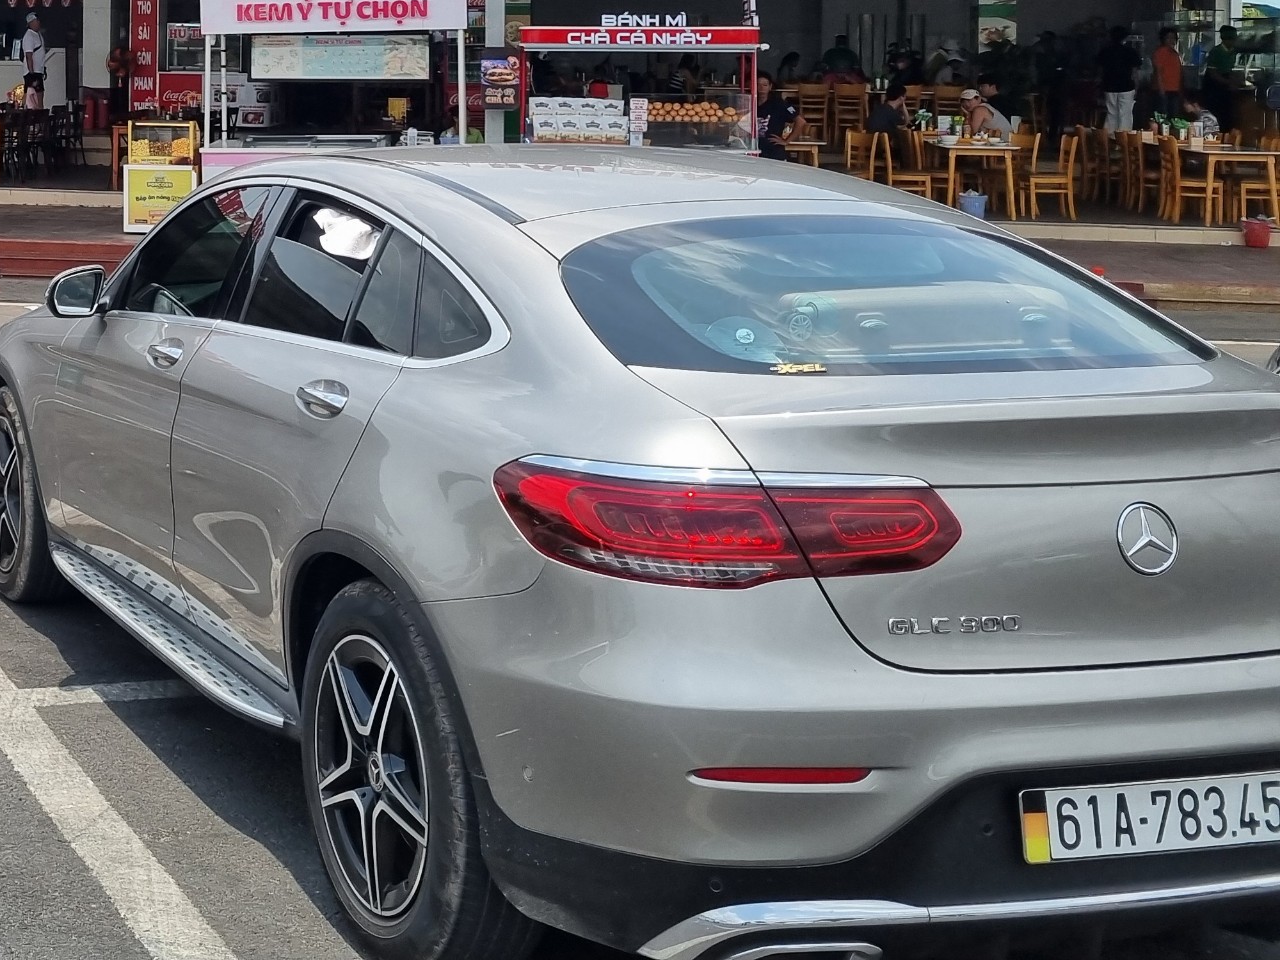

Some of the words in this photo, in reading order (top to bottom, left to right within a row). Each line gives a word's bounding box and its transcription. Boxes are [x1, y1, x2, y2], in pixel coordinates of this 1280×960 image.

[136, 0, 153, 15] THO
[236, 1, 294, 23] KEM
[601, 12, 658, 26] BÁNH
[666, 11, 687, 26] MÌ
[137, 22, 151, 41] SÀI
[136, 48, 152, 66] GÒN
[133, 76, 154, 91] PHAN
[776, 363, 828, 374] XPEL
[887, 616, 951, 635] GLC
[959, 614, 1020, 633] 300
[1055, 781, 1280, 851] 61A-783.45
